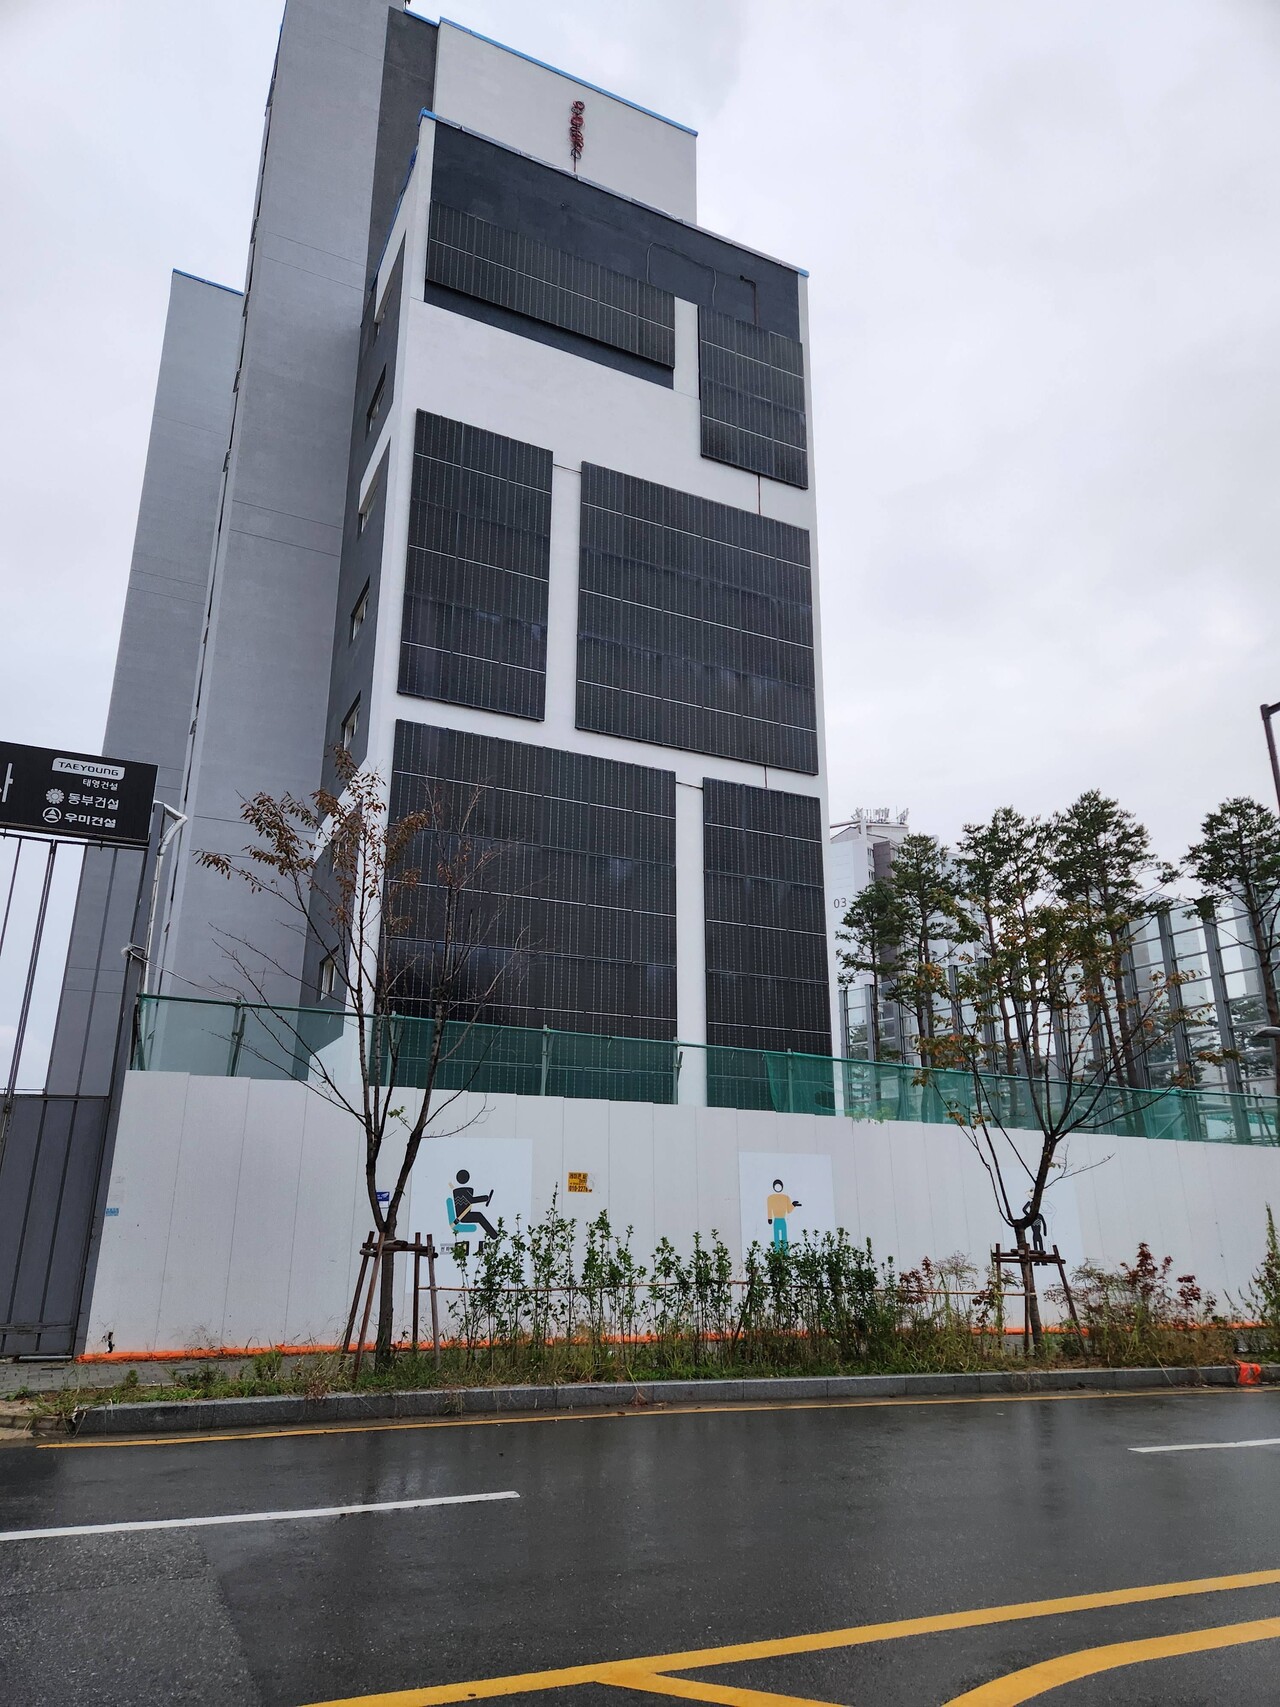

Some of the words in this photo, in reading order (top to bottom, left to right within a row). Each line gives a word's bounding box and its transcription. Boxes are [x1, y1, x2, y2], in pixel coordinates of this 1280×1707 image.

[58, 761, 119, 776] TAEYOUNG
[82, 778, 119, 791] 태영건설
[68, 792, 119, 811] 동부건설
[64, 812, 117, 829] 우미건설
